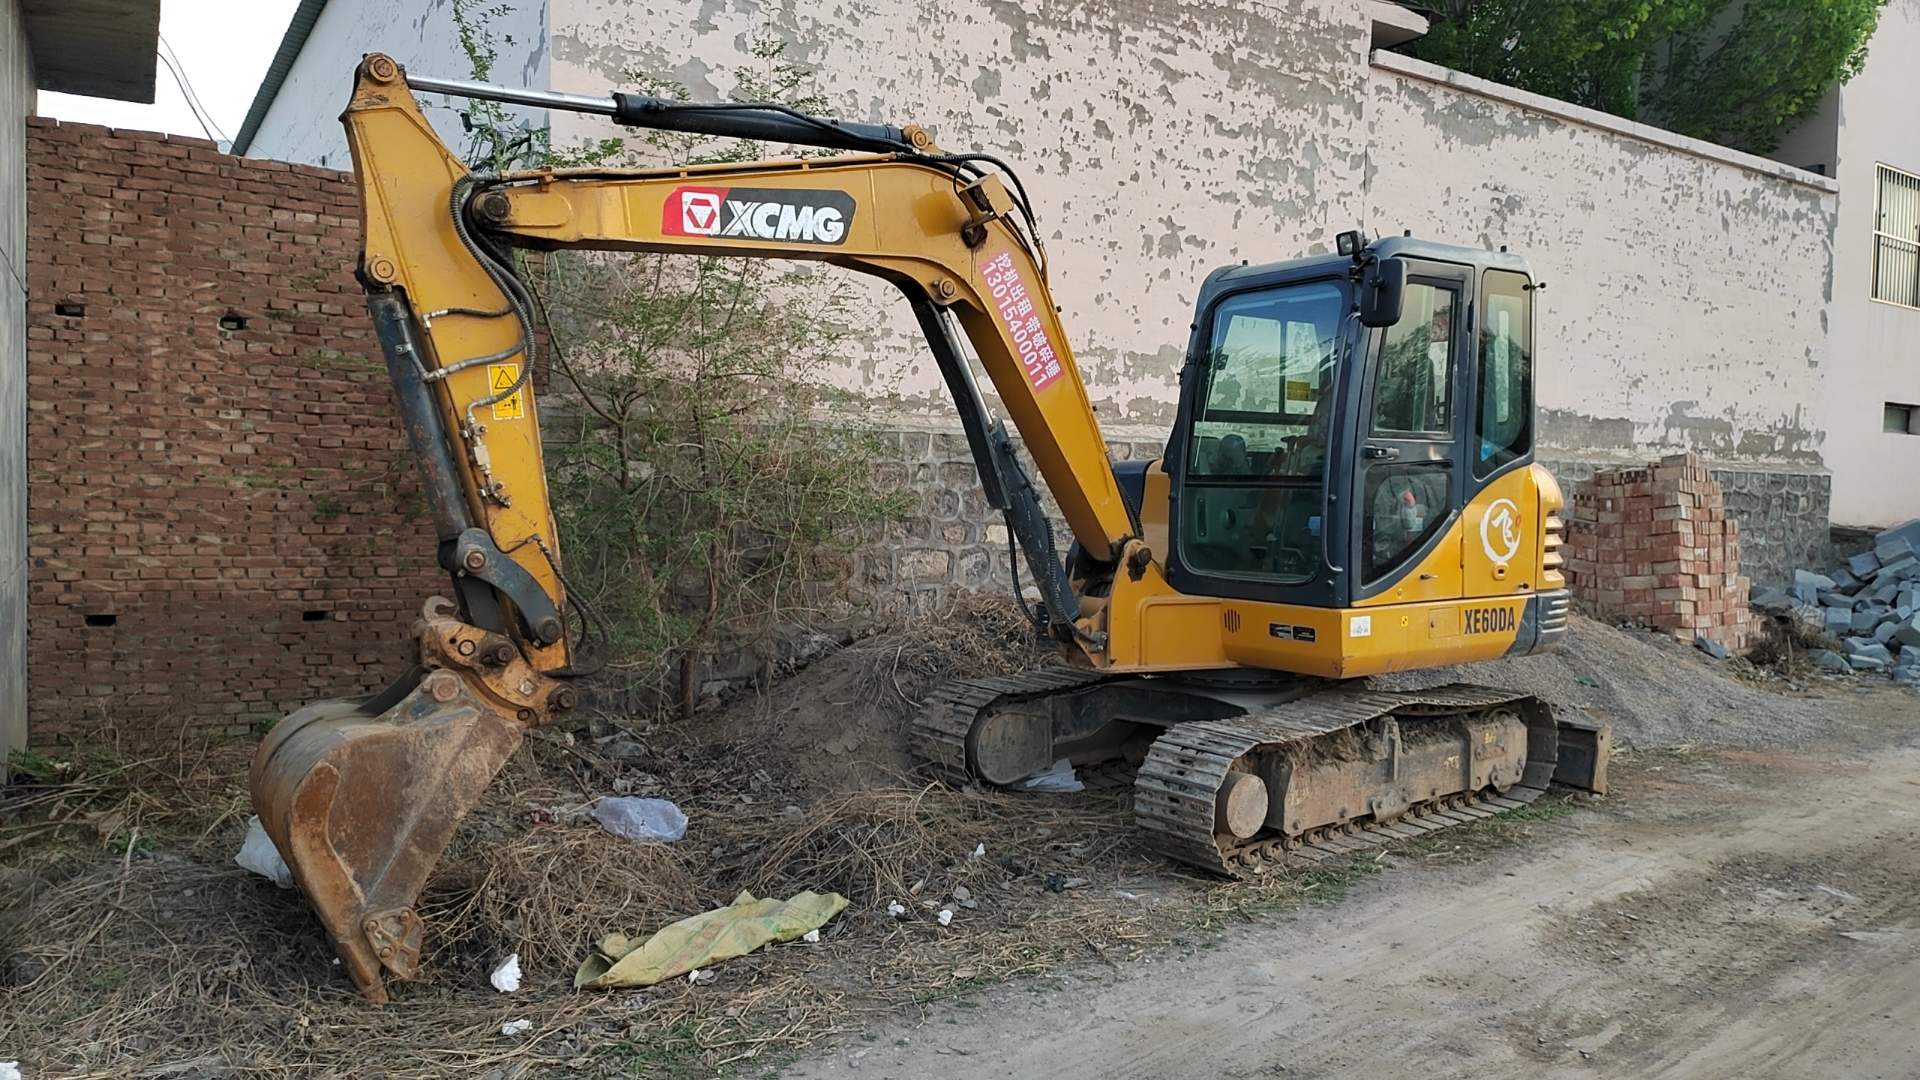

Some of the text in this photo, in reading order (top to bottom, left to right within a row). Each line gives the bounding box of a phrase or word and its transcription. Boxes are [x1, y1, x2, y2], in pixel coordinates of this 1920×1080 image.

[721, 200, 844, 243] XCMG
[983, 263, 1047, 387] 13015400011
[1464, 607, 1516, 634] XE60DA
